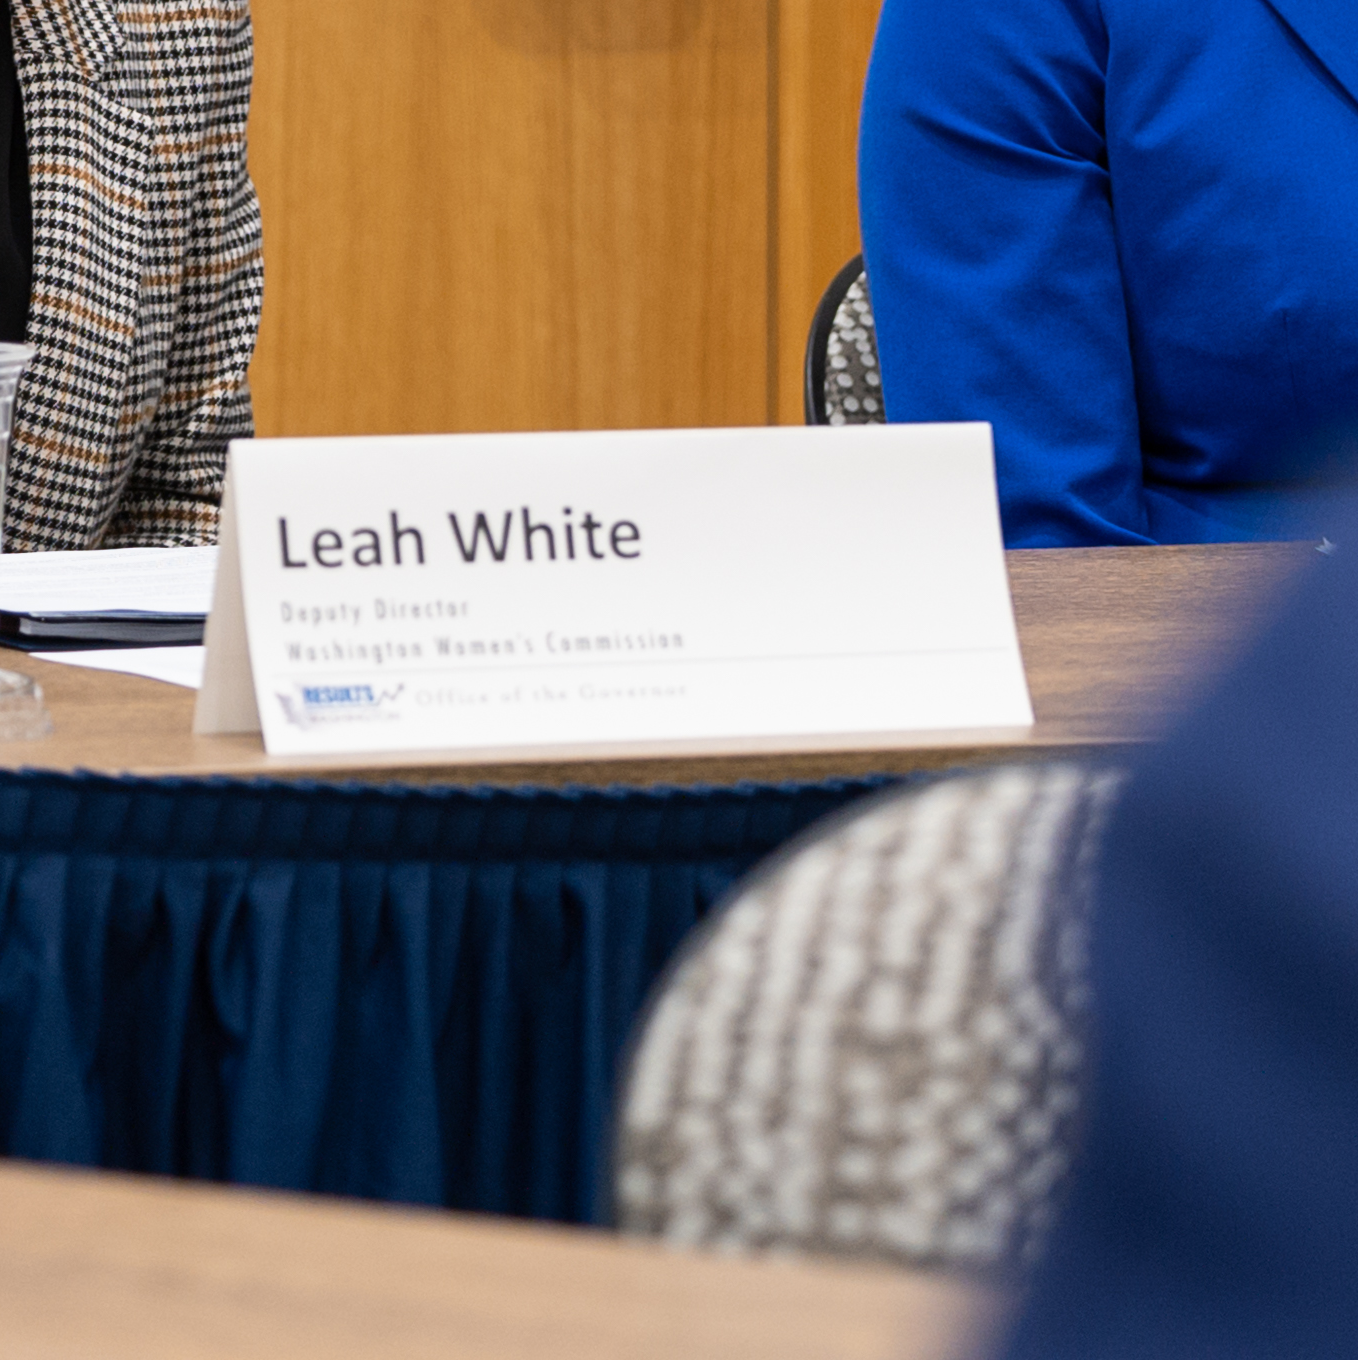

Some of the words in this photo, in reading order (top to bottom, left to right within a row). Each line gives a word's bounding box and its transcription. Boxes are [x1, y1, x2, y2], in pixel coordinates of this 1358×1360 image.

[278, 510, 425, 568] Leah
[447, 506, 642, 563] White
[281, 602, 360, 626] Deputy
[374, 597, 468, 620] Director
[287, 641, 423, 664] Washington
[435, 633, 534, 656] Women's
[546, 629, 684, 652] Commission
[303, 686, 374, 704] RESULTS
[415, 688, 489, 707] Office
[501, 686, 523, 703] of
[533, 684, 569, 701] the
[579, 683, 688, 700] Governor
